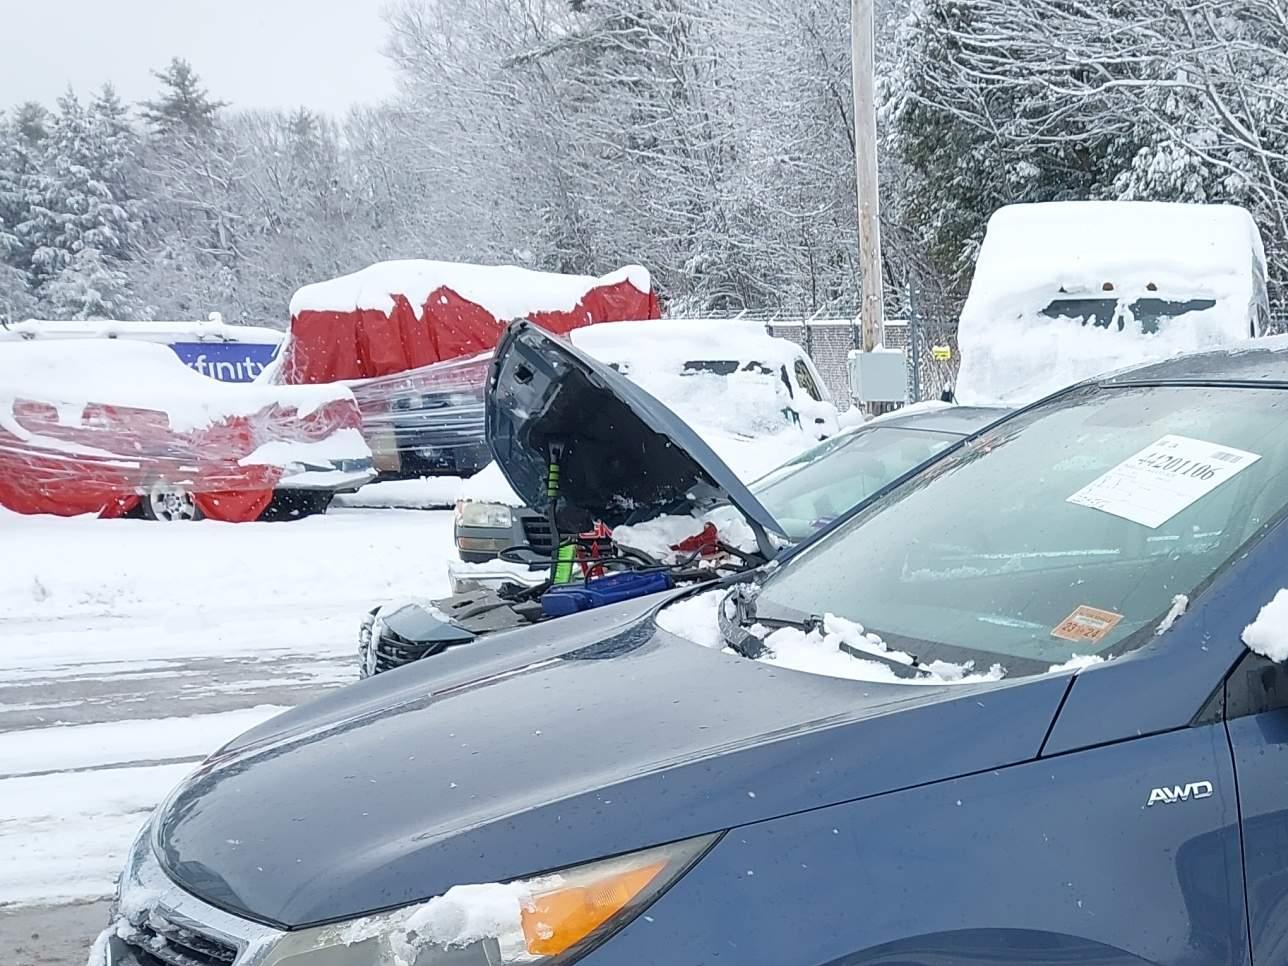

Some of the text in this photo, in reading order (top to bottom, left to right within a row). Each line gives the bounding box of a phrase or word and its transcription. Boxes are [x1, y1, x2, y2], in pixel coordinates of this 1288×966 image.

[188, 354, 264, 380] finit
[1138, 452, 1218, 480] 44201106
[1147, 780, 1213, 806] AWD
